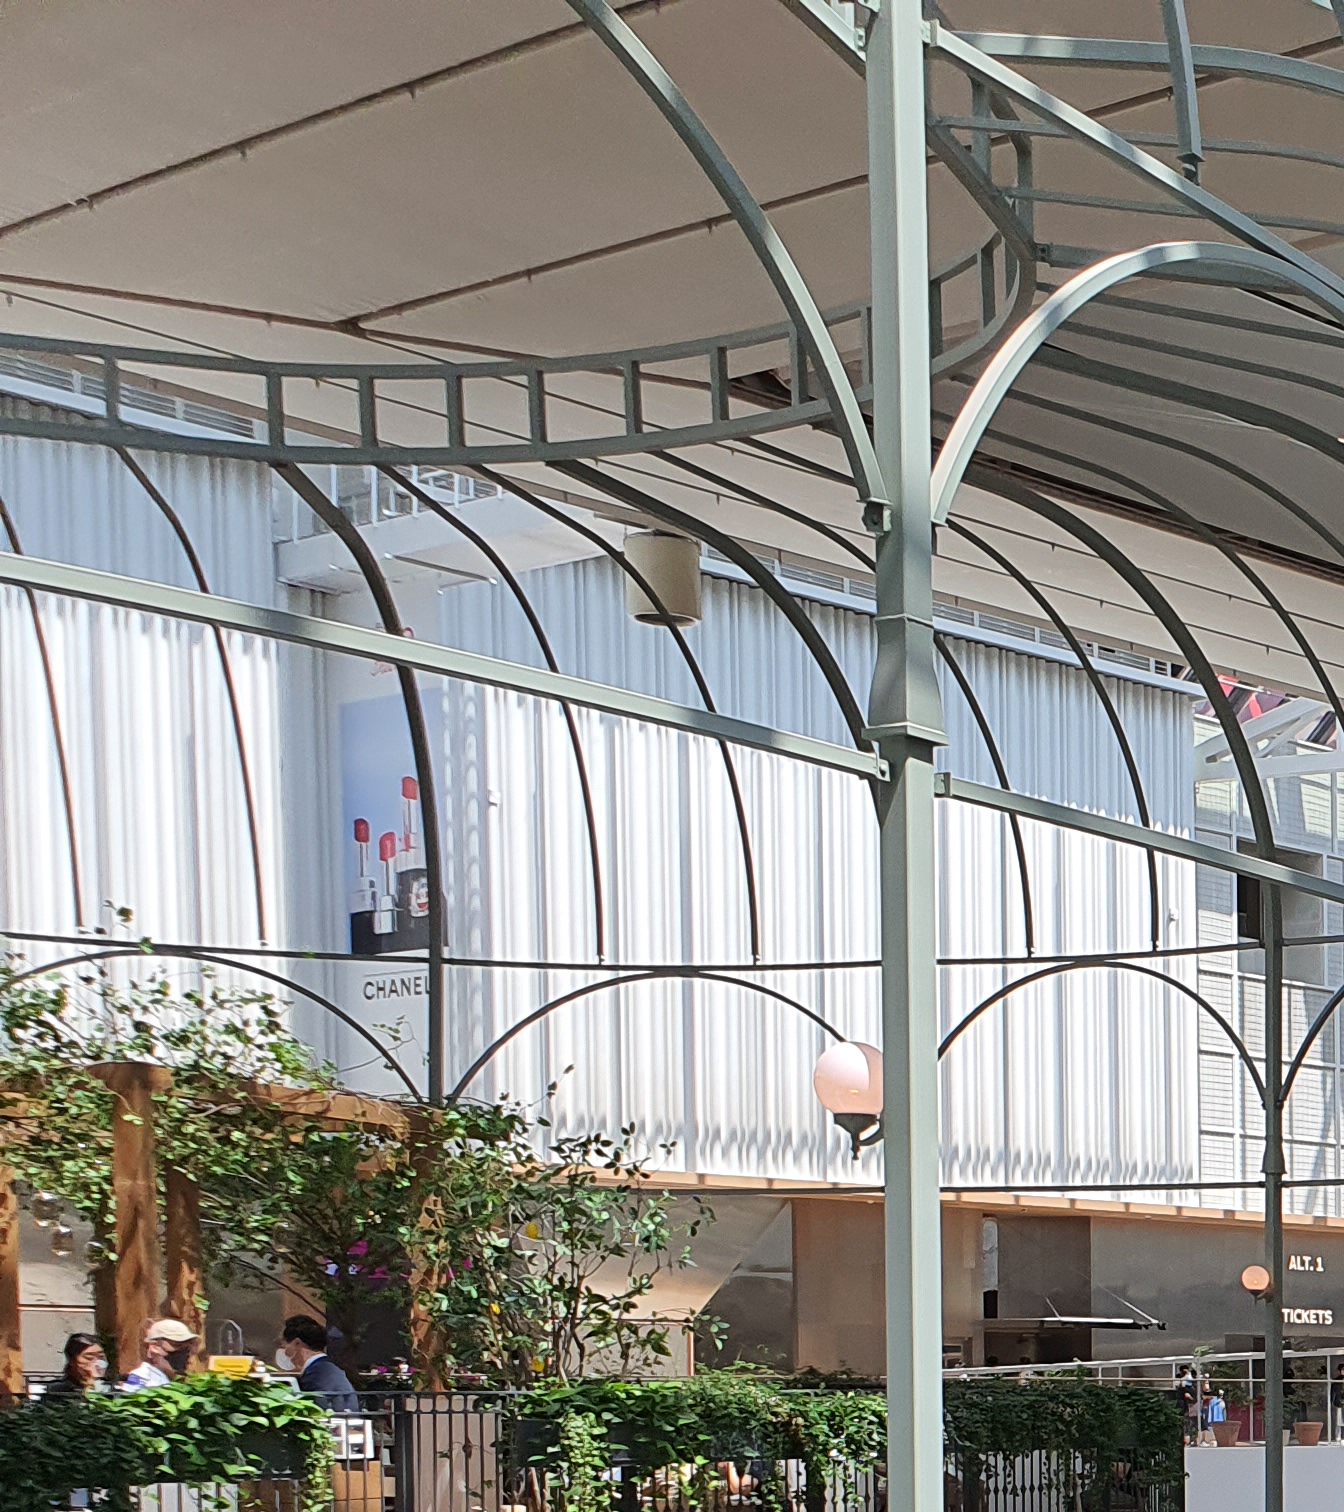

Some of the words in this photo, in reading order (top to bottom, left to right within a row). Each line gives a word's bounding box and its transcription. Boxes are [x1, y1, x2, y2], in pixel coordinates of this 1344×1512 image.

[363, 976, 430, 1000] CHANEL
[1288, 1255, 1314, 1271] ALT.
[1316, 1257, 1324, 1272] 1
[1281, 1308, 1333, 1325] TICKETS
